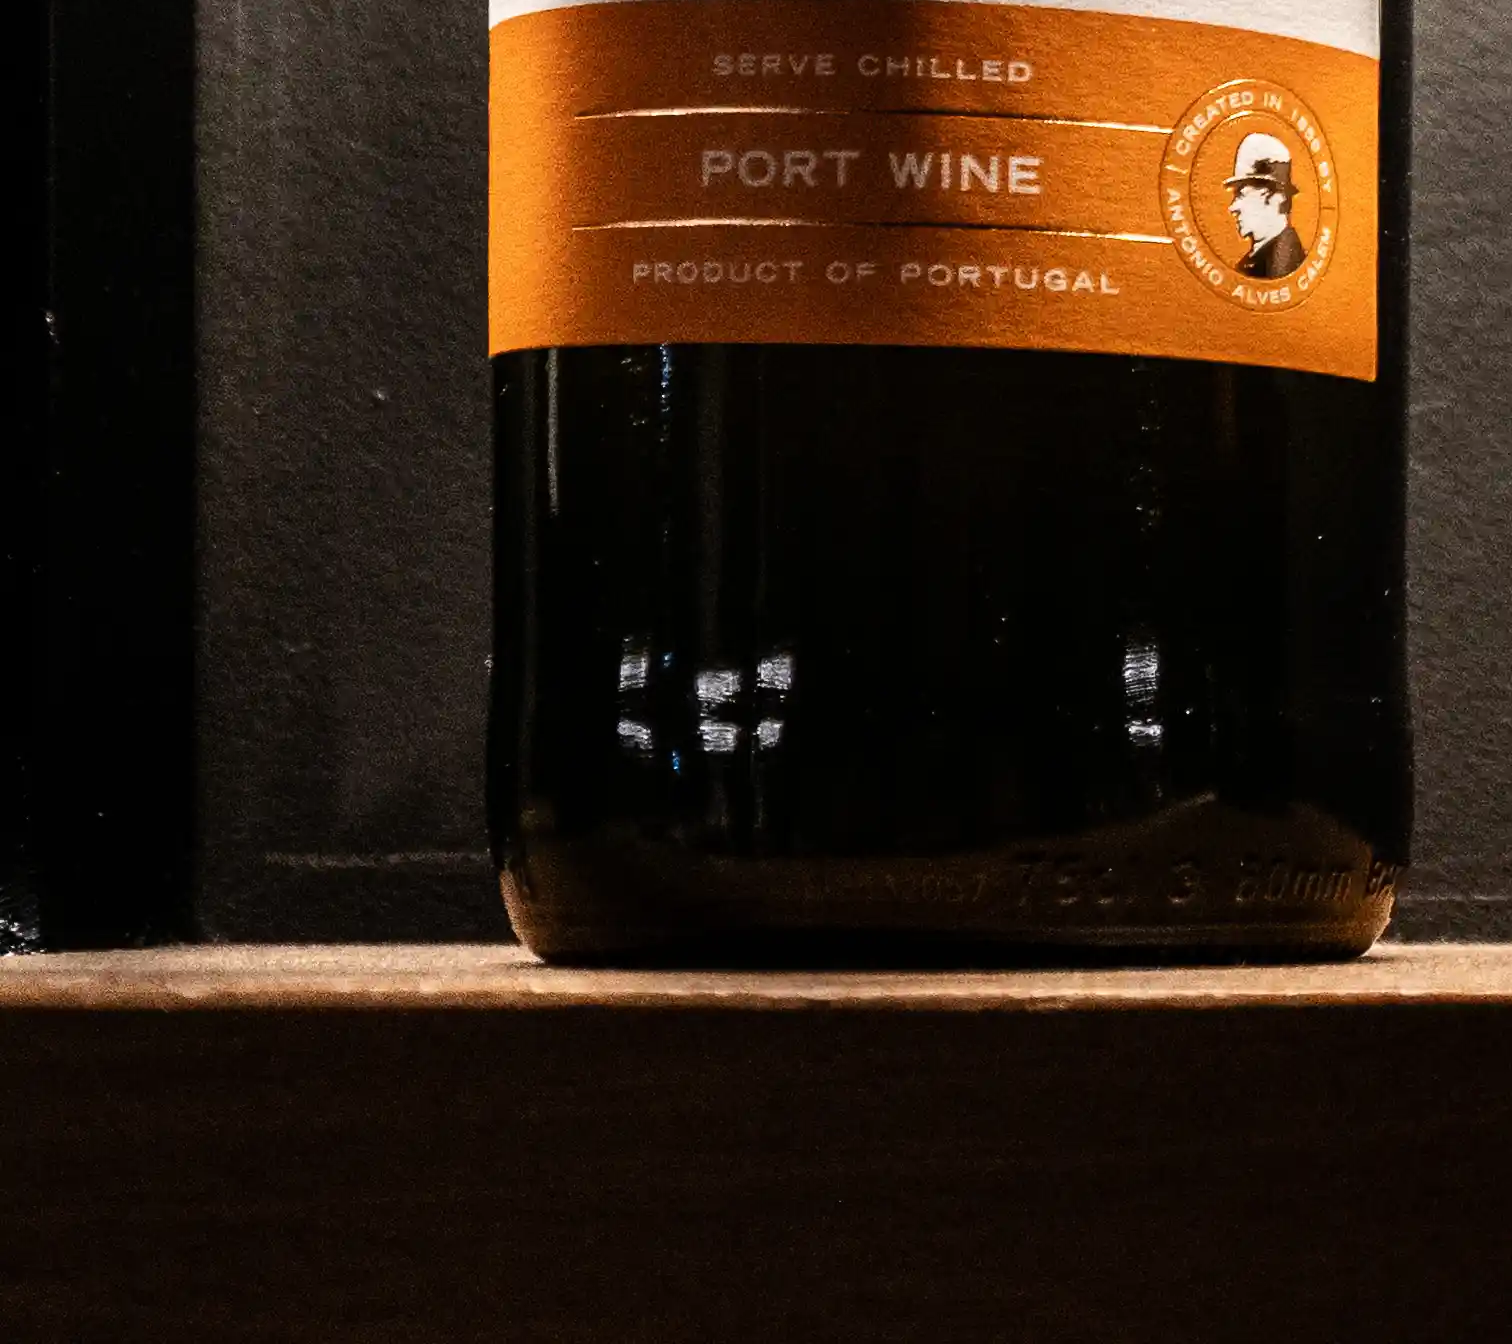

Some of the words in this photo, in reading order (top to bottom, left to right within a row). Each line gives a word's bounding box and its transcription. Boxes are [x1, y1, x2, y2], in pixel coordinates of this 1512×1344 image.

[710, 50, 834, 80] SERVE
[857, 51, 1035, 86] CHILLED
[1175, 90, 1255, 156] CREATED
[1263, 91, 1283, 113] IN
[699, 148, 860, 191] PORT
[887, 150, 1043, 196] WINE
[631, 258, 804, 286] PRODUCT
[826, 260, 879, 287] OF
[899, 262, 1121, 296] PORTUGAL
[1231, 283, 1293, 306] ALVES
